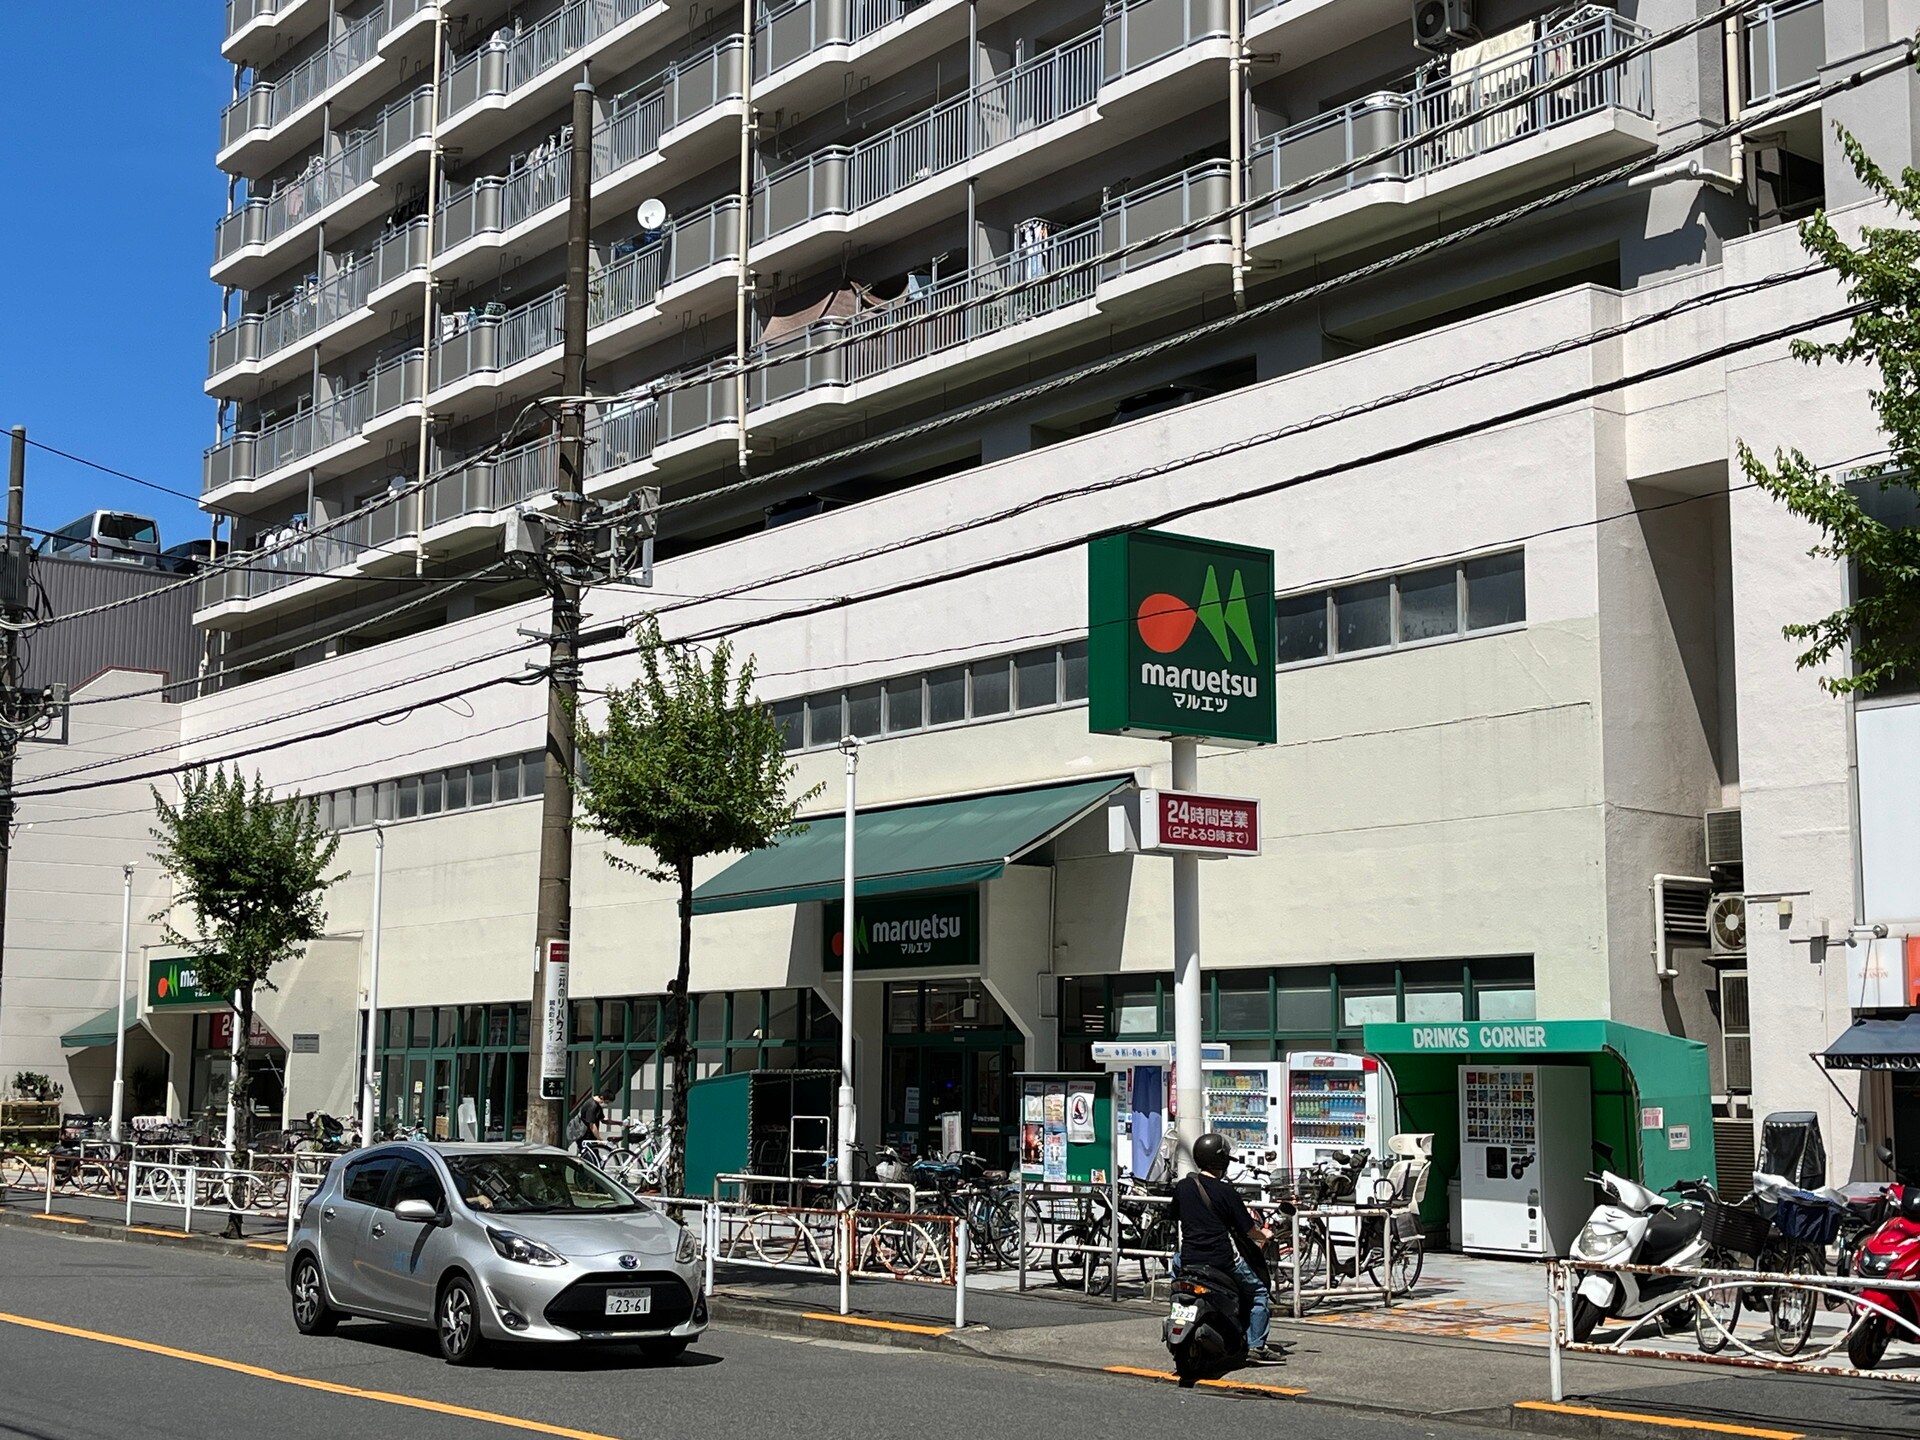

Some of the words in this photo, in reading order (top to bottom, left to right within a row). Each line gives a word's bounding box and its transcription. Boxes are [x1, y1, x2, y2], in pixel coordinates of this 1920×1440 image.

[1141, 662, 1258, 698] maruetsu
[1172, 692, 1228, 714] マルエツ
[1167, 800, 1249, 829] 24時間営業
[1167, 825, 1249, 845] (2Fよる9時まで)
[872, 914, 961, 943] maruetsu
[900, 942, 931, 955] マルエツ
[556, 966, 566, 1041] 三井のリハウス
[1412, 1027, 1470, 1049] DRINKS
[1479, 1025, 1547, 1048] CORNER
[615, 1298, 647, 1313] 23-61
